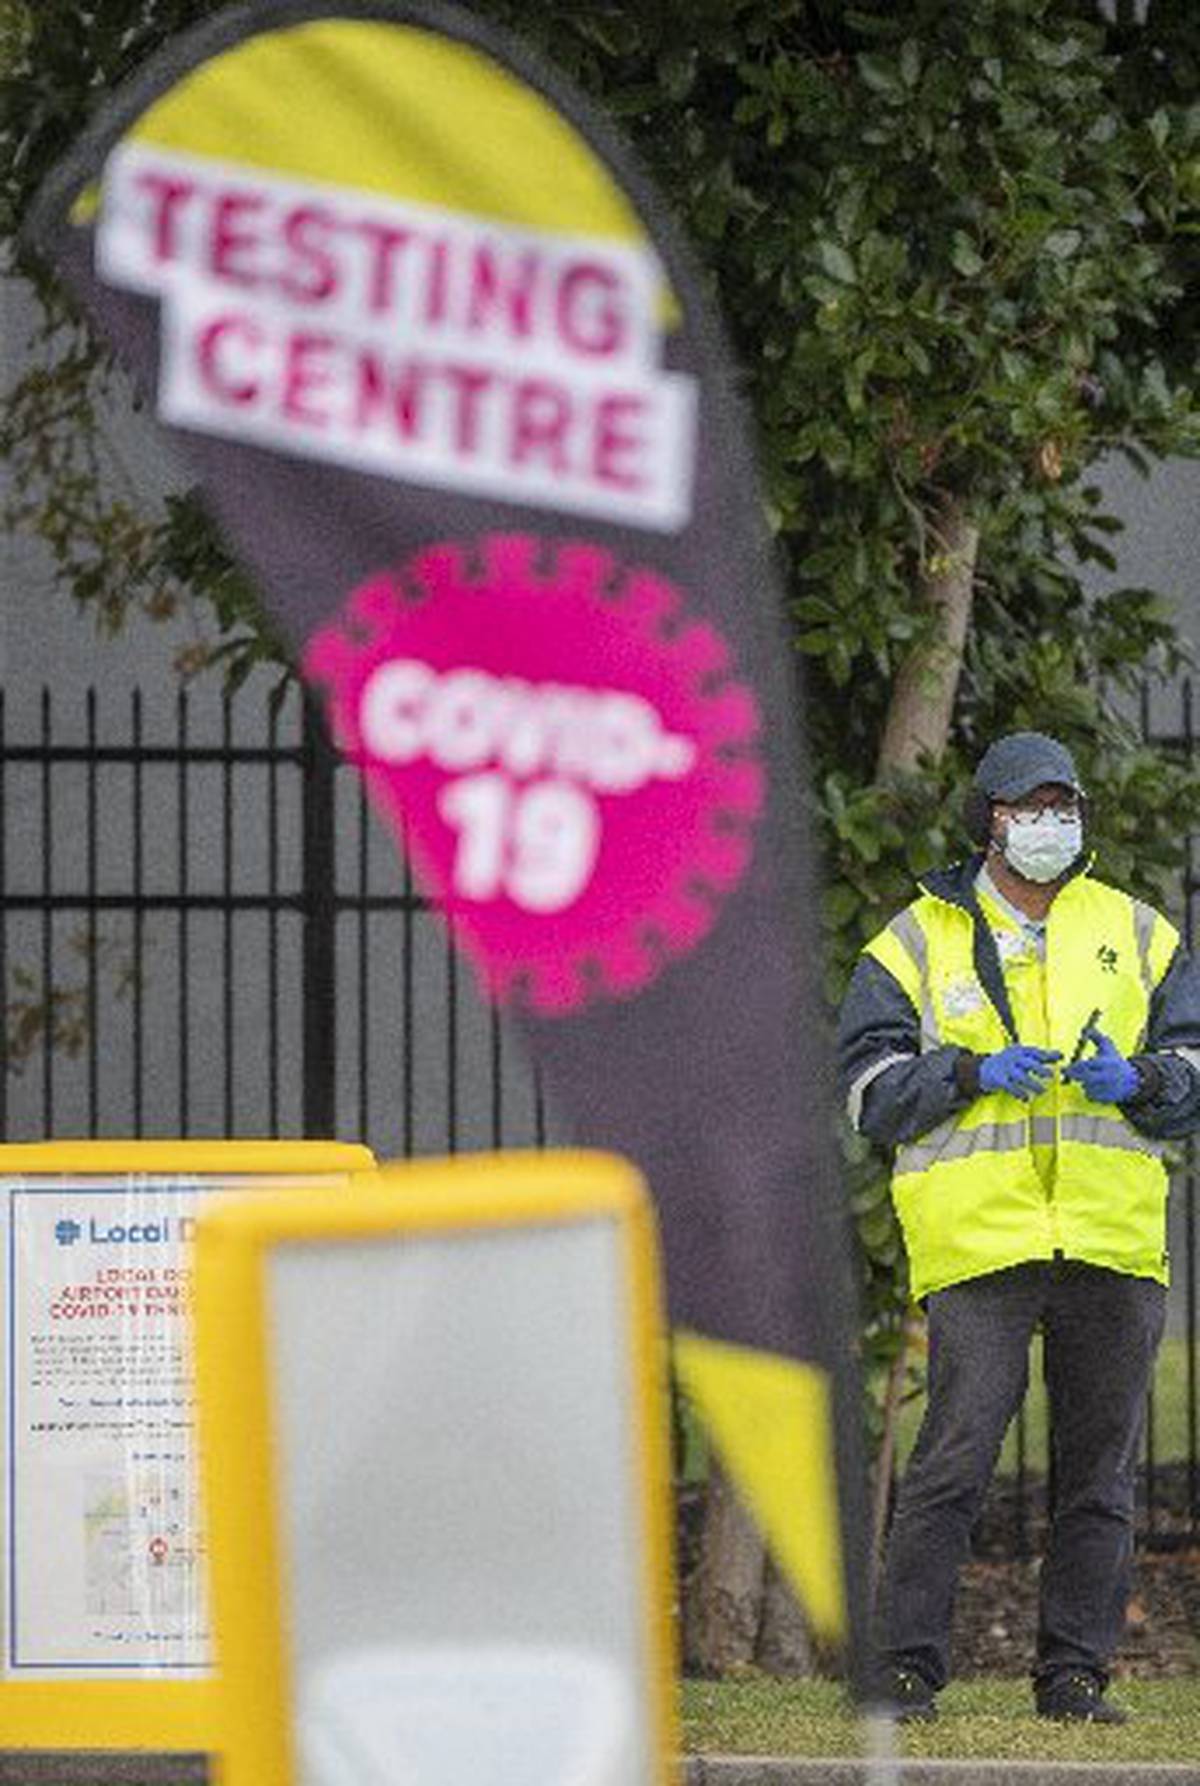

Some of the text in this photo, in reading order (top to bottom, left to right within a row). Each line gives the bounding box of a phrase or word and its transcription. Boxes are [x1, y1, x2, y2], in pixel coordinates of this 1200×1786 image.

[134, 172, 628, 359] TESTING
[198, 312, 650, 490] CENTRE
[360, 660, 696, 794] COVID-
[434, 771, 602, 913] 19
[89, 1216, 169, 1243] Local
